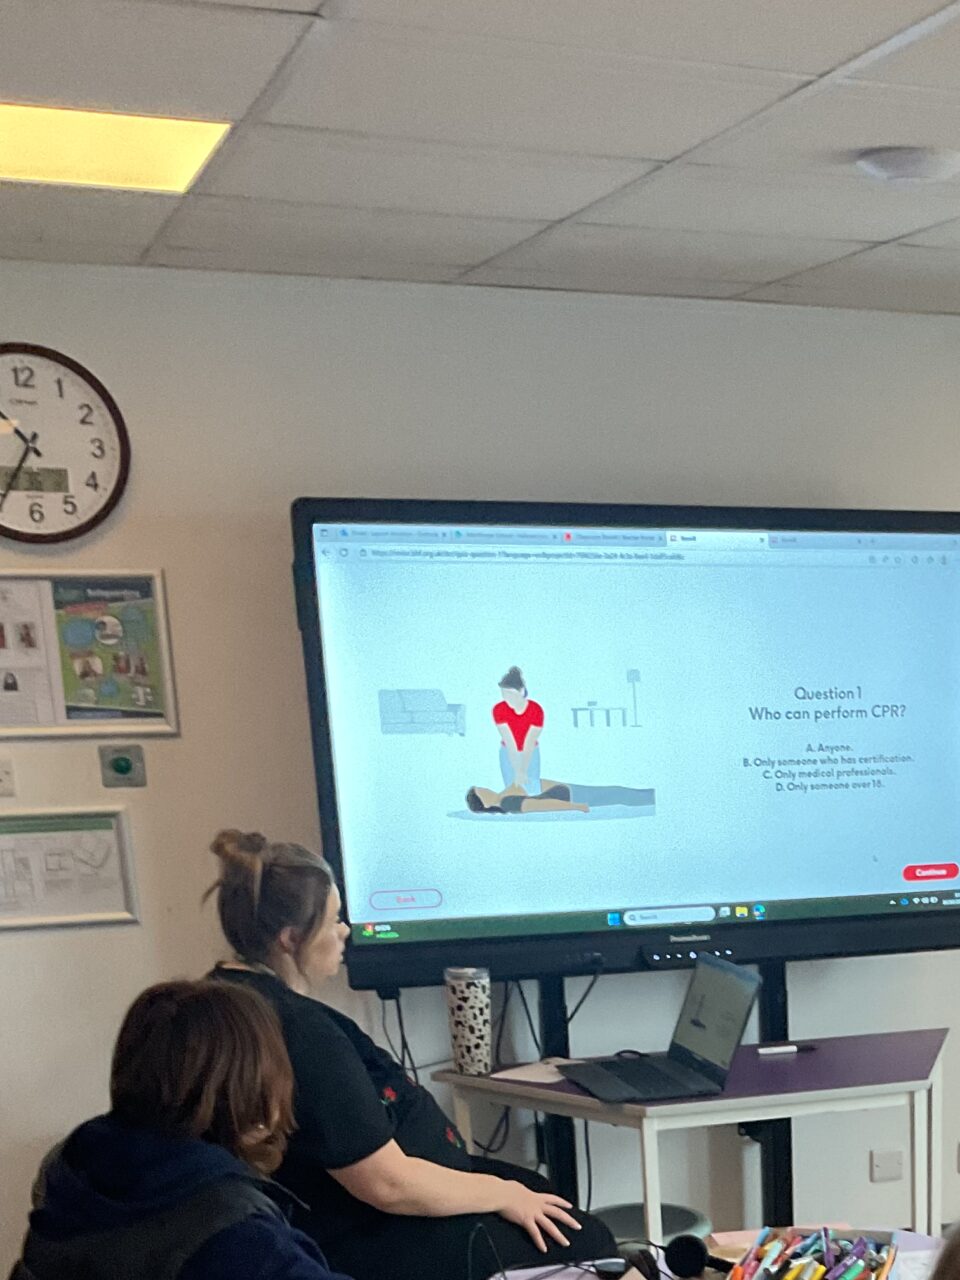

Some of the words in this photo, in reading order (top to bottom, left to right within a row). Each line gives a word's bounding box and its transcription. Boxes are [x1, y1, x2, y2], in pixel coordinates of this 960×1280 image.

[12, 367, 36, 388] 12
[56, 377, 64, 399] 1
[79, 404, 94, 425] 2
[91, 439, 105, 459] 3
[86, 471, 99, 491] 4
[30, 503, 45, 523] 6
[63, 495, 77, 515] 5
[794, 687, 854, 700] Question
[749, 707, 781, 720] Who
[785, 709, 810, 719] can
[814, 706, 867, 723] perform
[871, 705, 906, 718] CPR?
[806, 744, 816, 752] A.
[818, 744, 853, 753] Anyone.
[743, 758, 752, 767] B.
[754, 758, 776, 768] Only
[820, 757, 838, 765] who
[841, 756, 856, 764] has
[859, 755, 914, 763] certification.
[763, 771, 772, 779] C.
[775, 770, 796, 780] Only
[799, 769, 834, 777] medical
[837, 768, 896, 779] professionals.
[787, 782, 808, 792] Only
